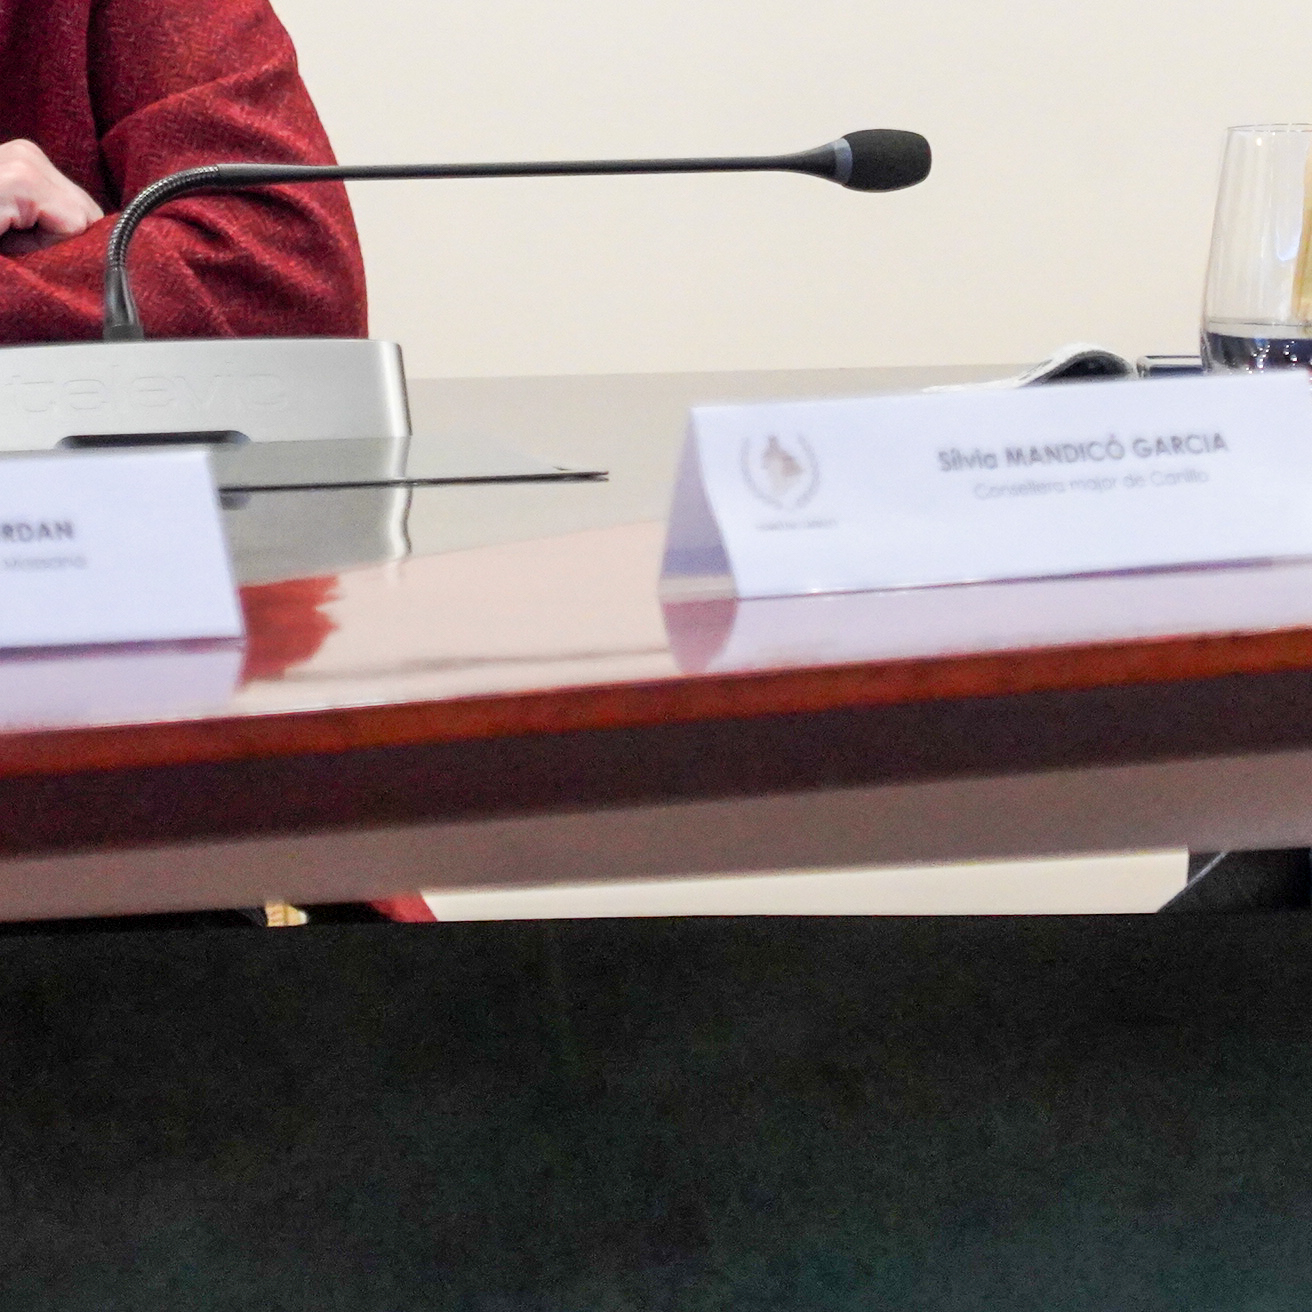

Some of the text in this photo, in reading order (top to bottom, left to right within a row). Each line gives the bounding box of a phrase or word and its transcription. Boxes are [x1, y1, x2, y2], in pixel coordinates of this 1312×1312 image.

[1005, 435, 1126, 466] MANDICÓ
[1132, 432, 1228, 458] GARCIA
[973, 468, 1210, 500] Consellera major de Canillo
